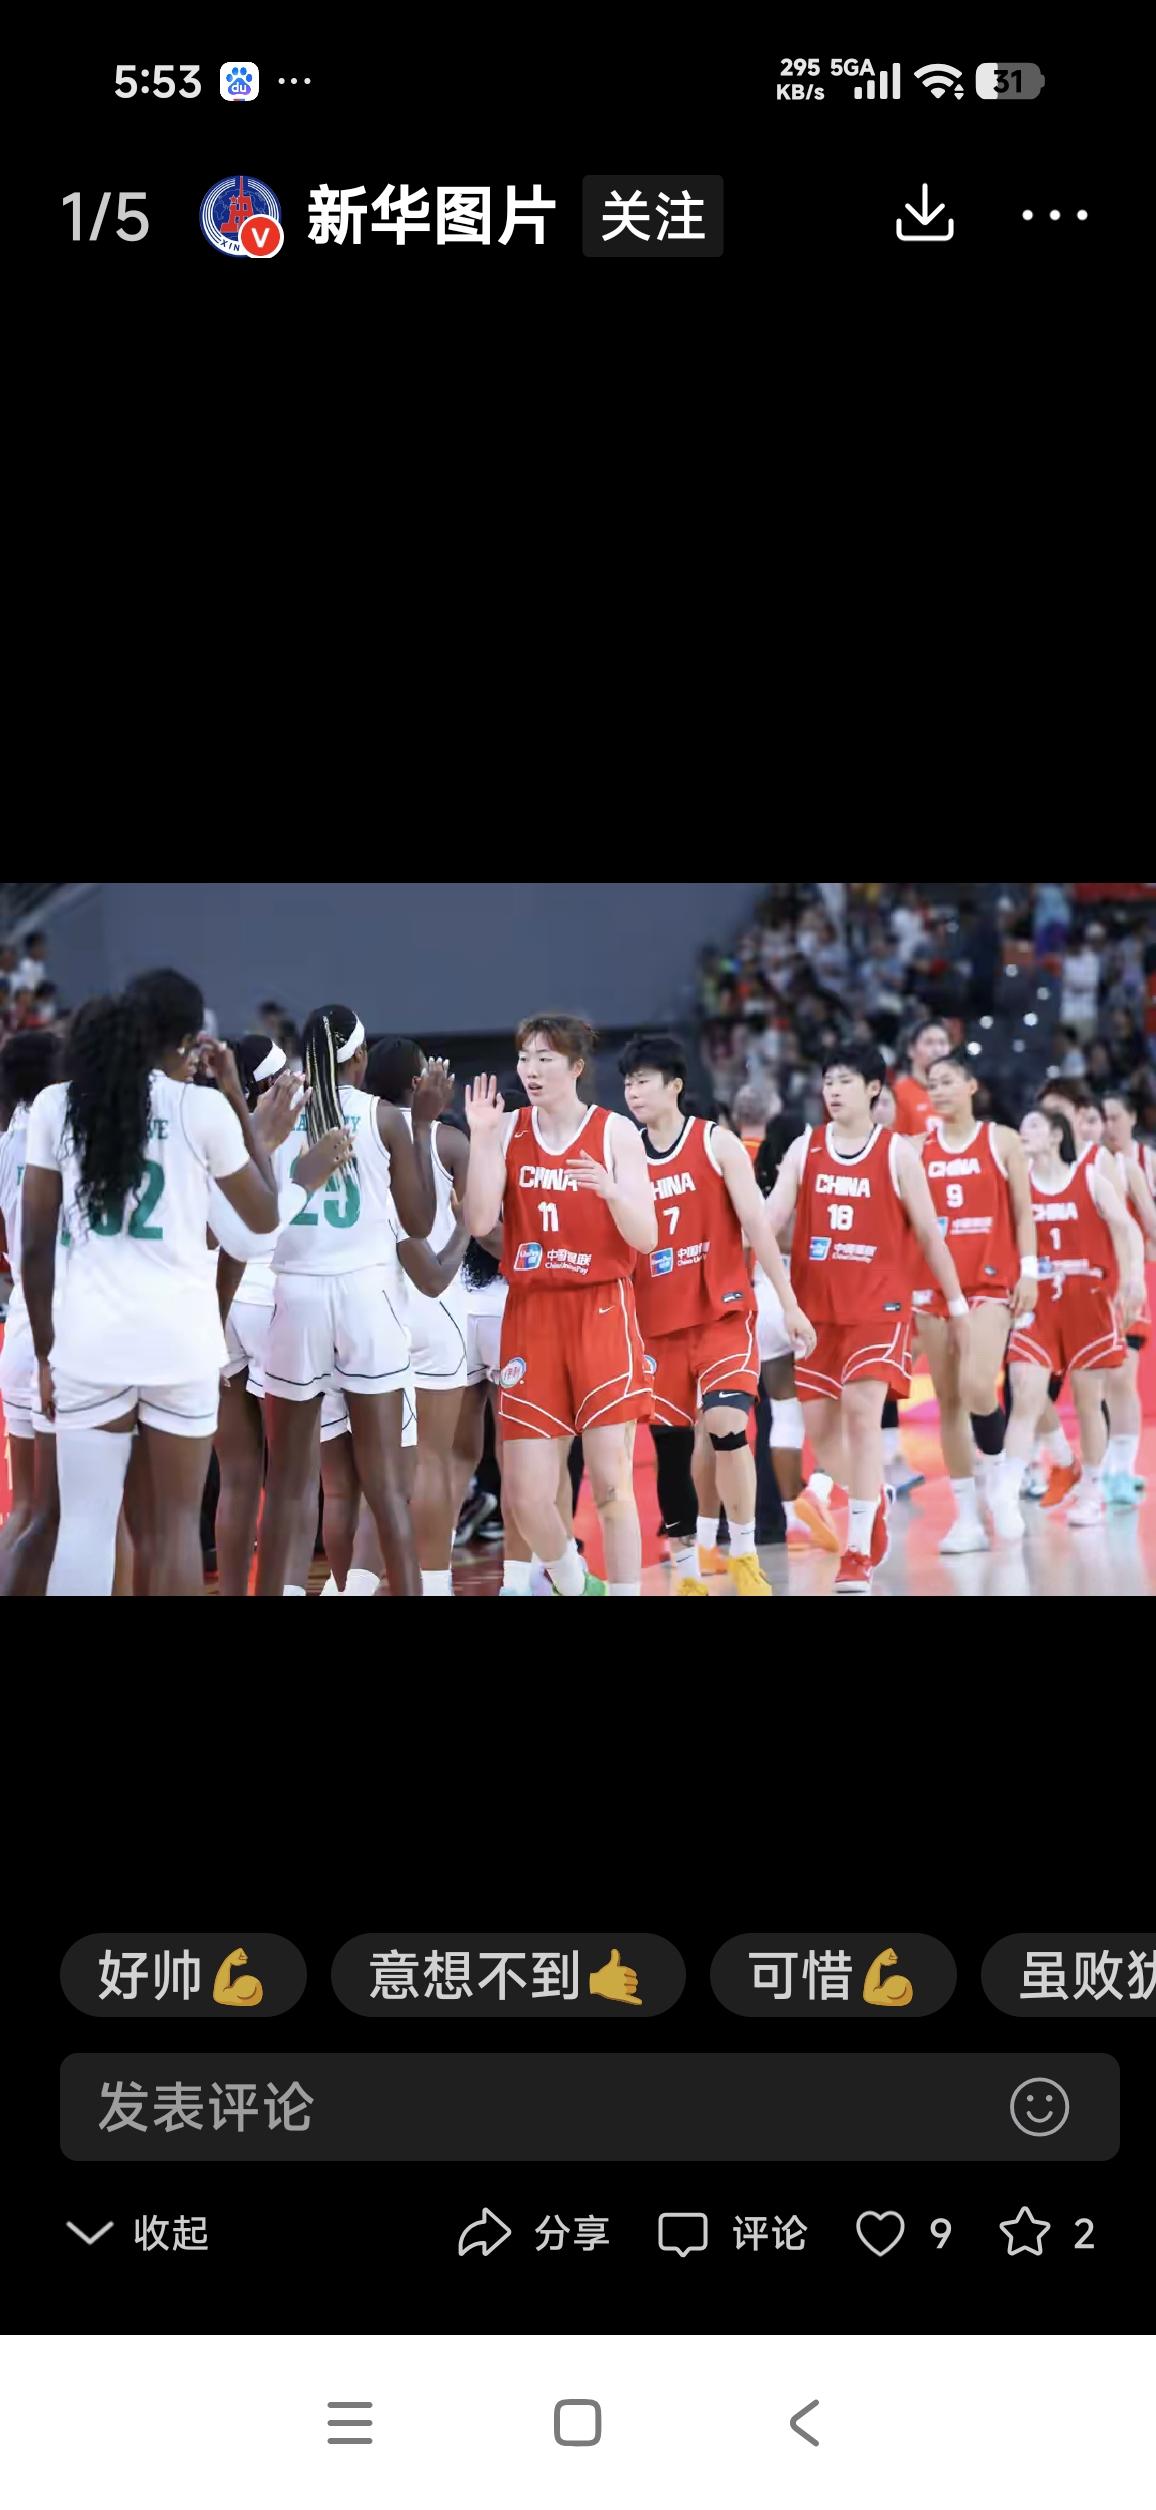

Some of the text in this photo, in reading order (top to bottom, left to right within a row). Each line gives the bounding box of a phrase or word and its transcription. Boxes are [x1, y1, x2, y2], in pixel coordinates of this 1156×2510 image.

[115, 65, 201, 98] 5:53
[781, 58, 820, 76] 295
[831, 58, 876, 76] 5GA
[993, 69, 1022, 93] 31
[231, 82, 247, 92] du
[777, 83, 825, 100] KB/s
[63, 192, 149, 241] 1/5
[308, 184, 556, 245] 新华图片
[602, 190, 705, 241] 关注
[650, 1172, 696, 1201] HINA
[815, 1174, 871, 1198] CHINA
[946, 1183, 964, 1208] 9
[538, 1201, 559, 1232] 11
[663, 1206, 680, 1235] 7
[827, 1203, 854, 1231] 18
[1049, 1227, 1062, 1250] 1
[99, 1949, 200, 2000] 好帅
[370, 1949, 578, 2000] 意想不到
[749, 1950, 852, 2000] 可惜
[99, 2081, 314, 2132] 发表评论
[135, 2215, 208, 2251] 收起
[535, 2215, 609, 2251] 分享
[733, 2215, 807, 2251] 评论
[931, 2218, 951, 2248] 9
[1075, 2218, 1094, 2248] 2
